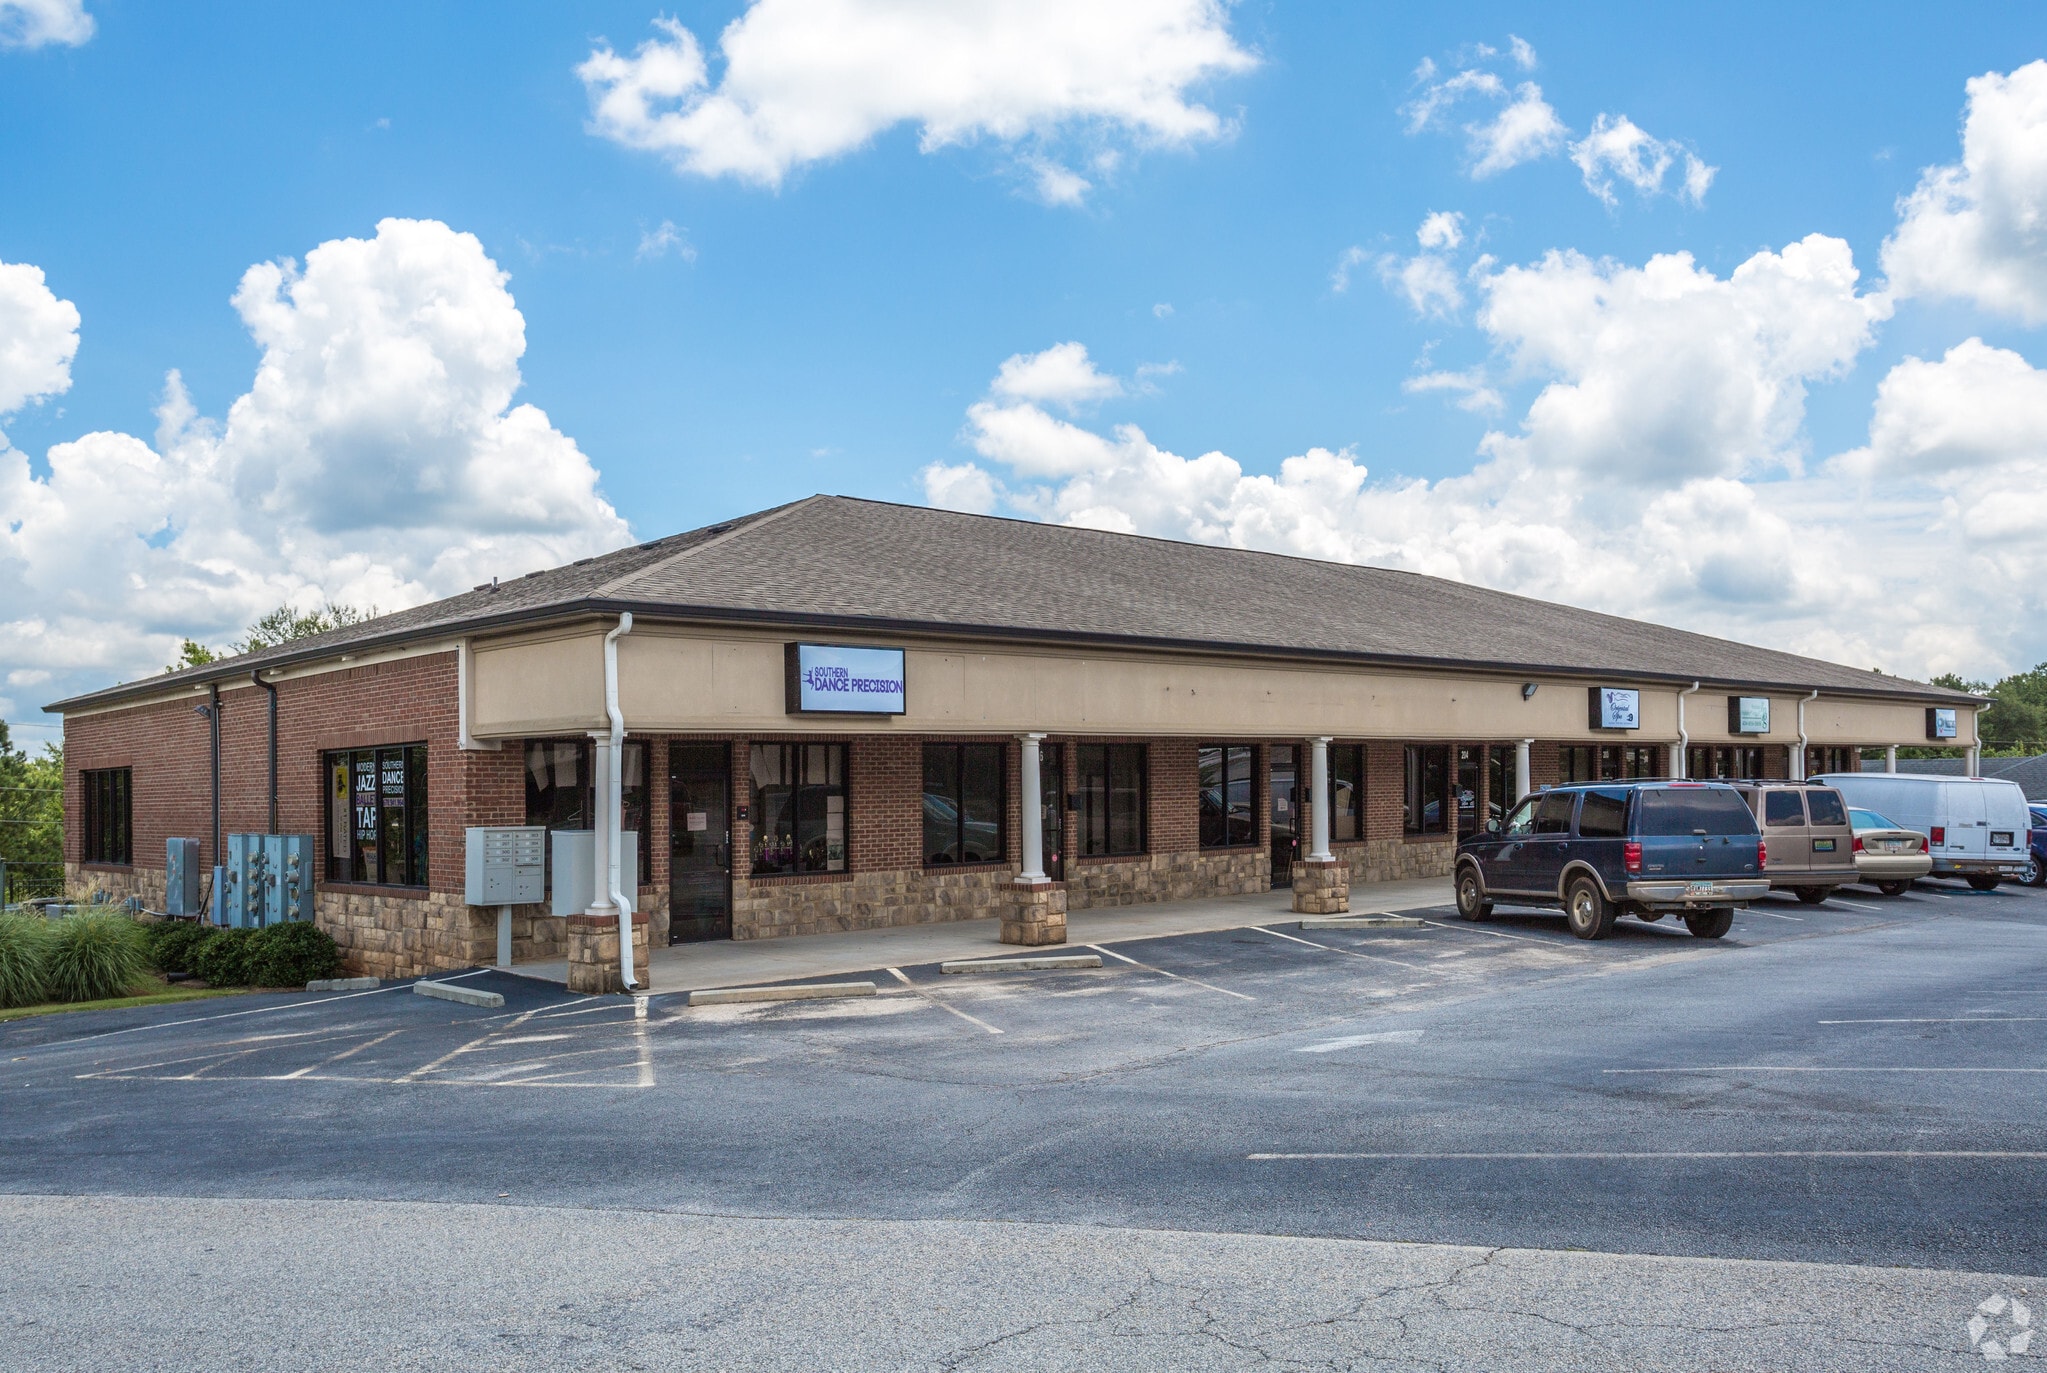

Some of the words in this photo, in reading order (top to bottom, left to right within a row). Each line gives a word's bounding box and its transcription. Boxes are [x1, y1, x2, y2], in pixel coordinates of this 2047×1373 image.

[815, 666, 848, 678] SOUTHERN
[815, 677, 849, 692] DANCE
[851, 678, 903, 694] PRECISION
[356, 775, 375, 792] JAZZ
[382, 771, 404, 784] DANCE
